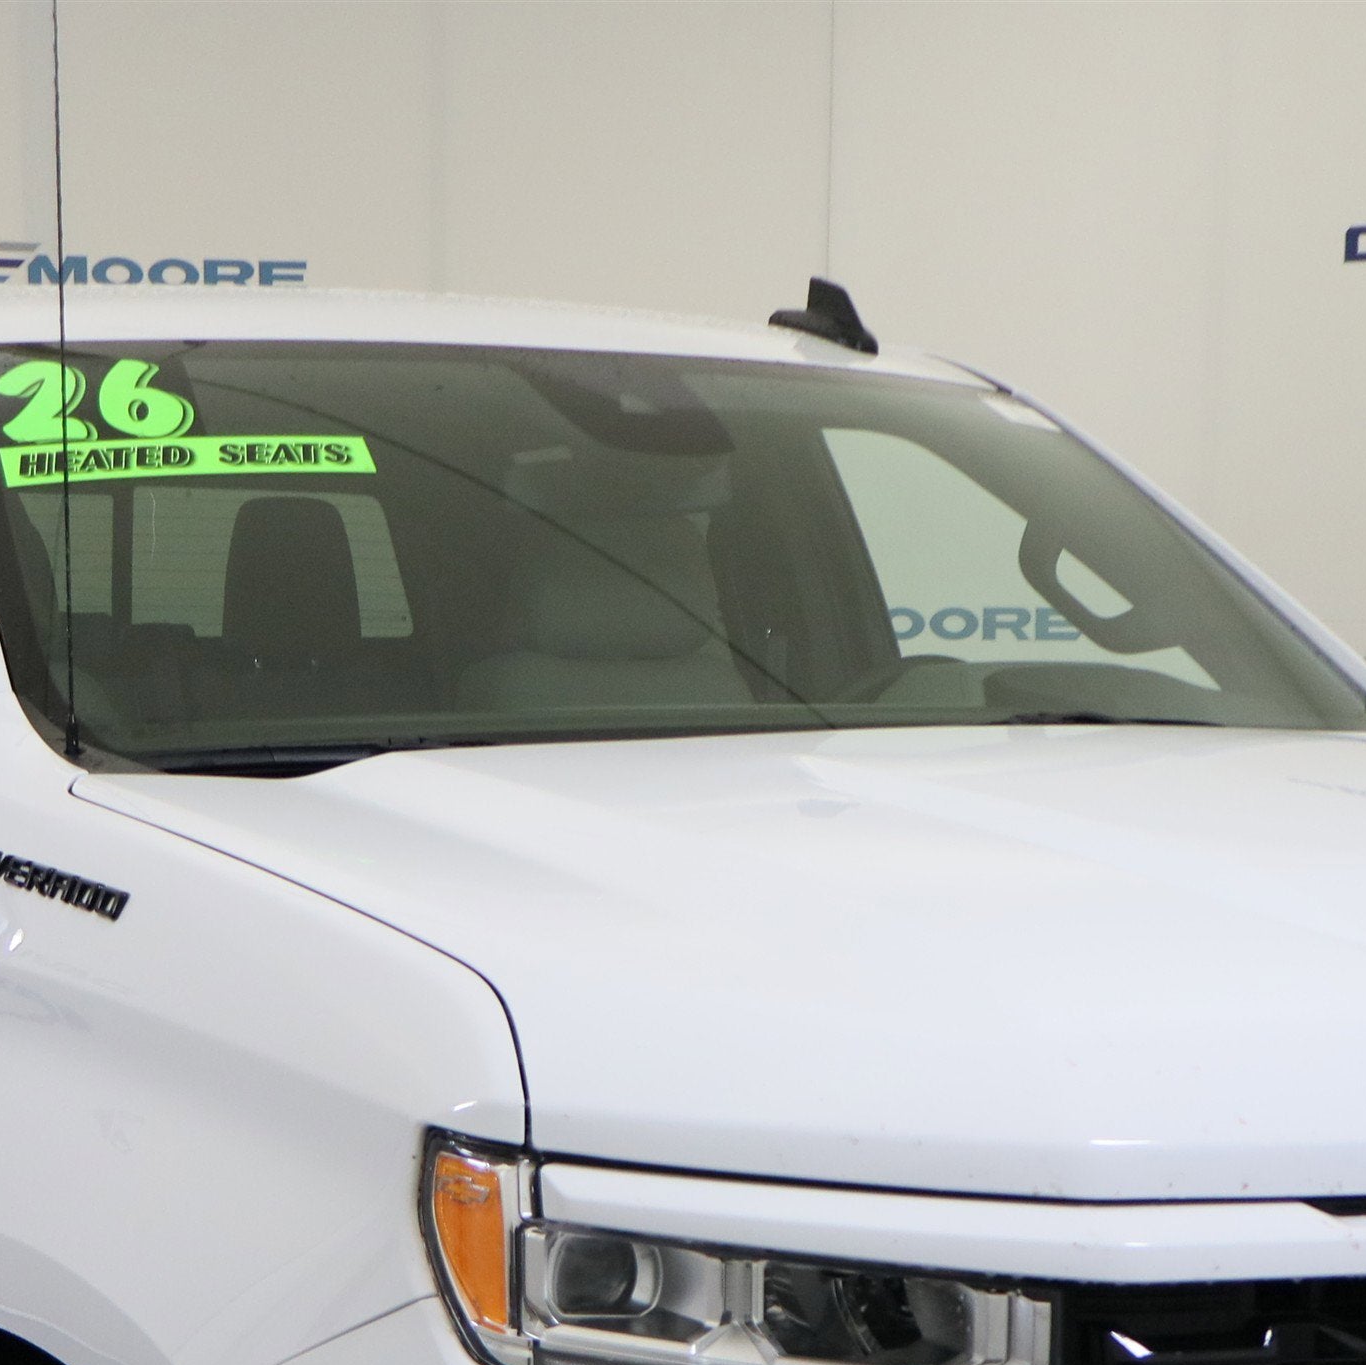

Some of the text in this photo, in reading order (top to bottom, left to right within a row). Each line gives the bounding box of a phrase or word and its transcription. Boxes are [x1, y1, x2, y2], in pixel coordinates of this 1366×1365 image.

[26, 253, 308, 286] MOORE
[18, 441, 354, 478] HEATED SEATS
[888, 605, 1084, 642] OORE
